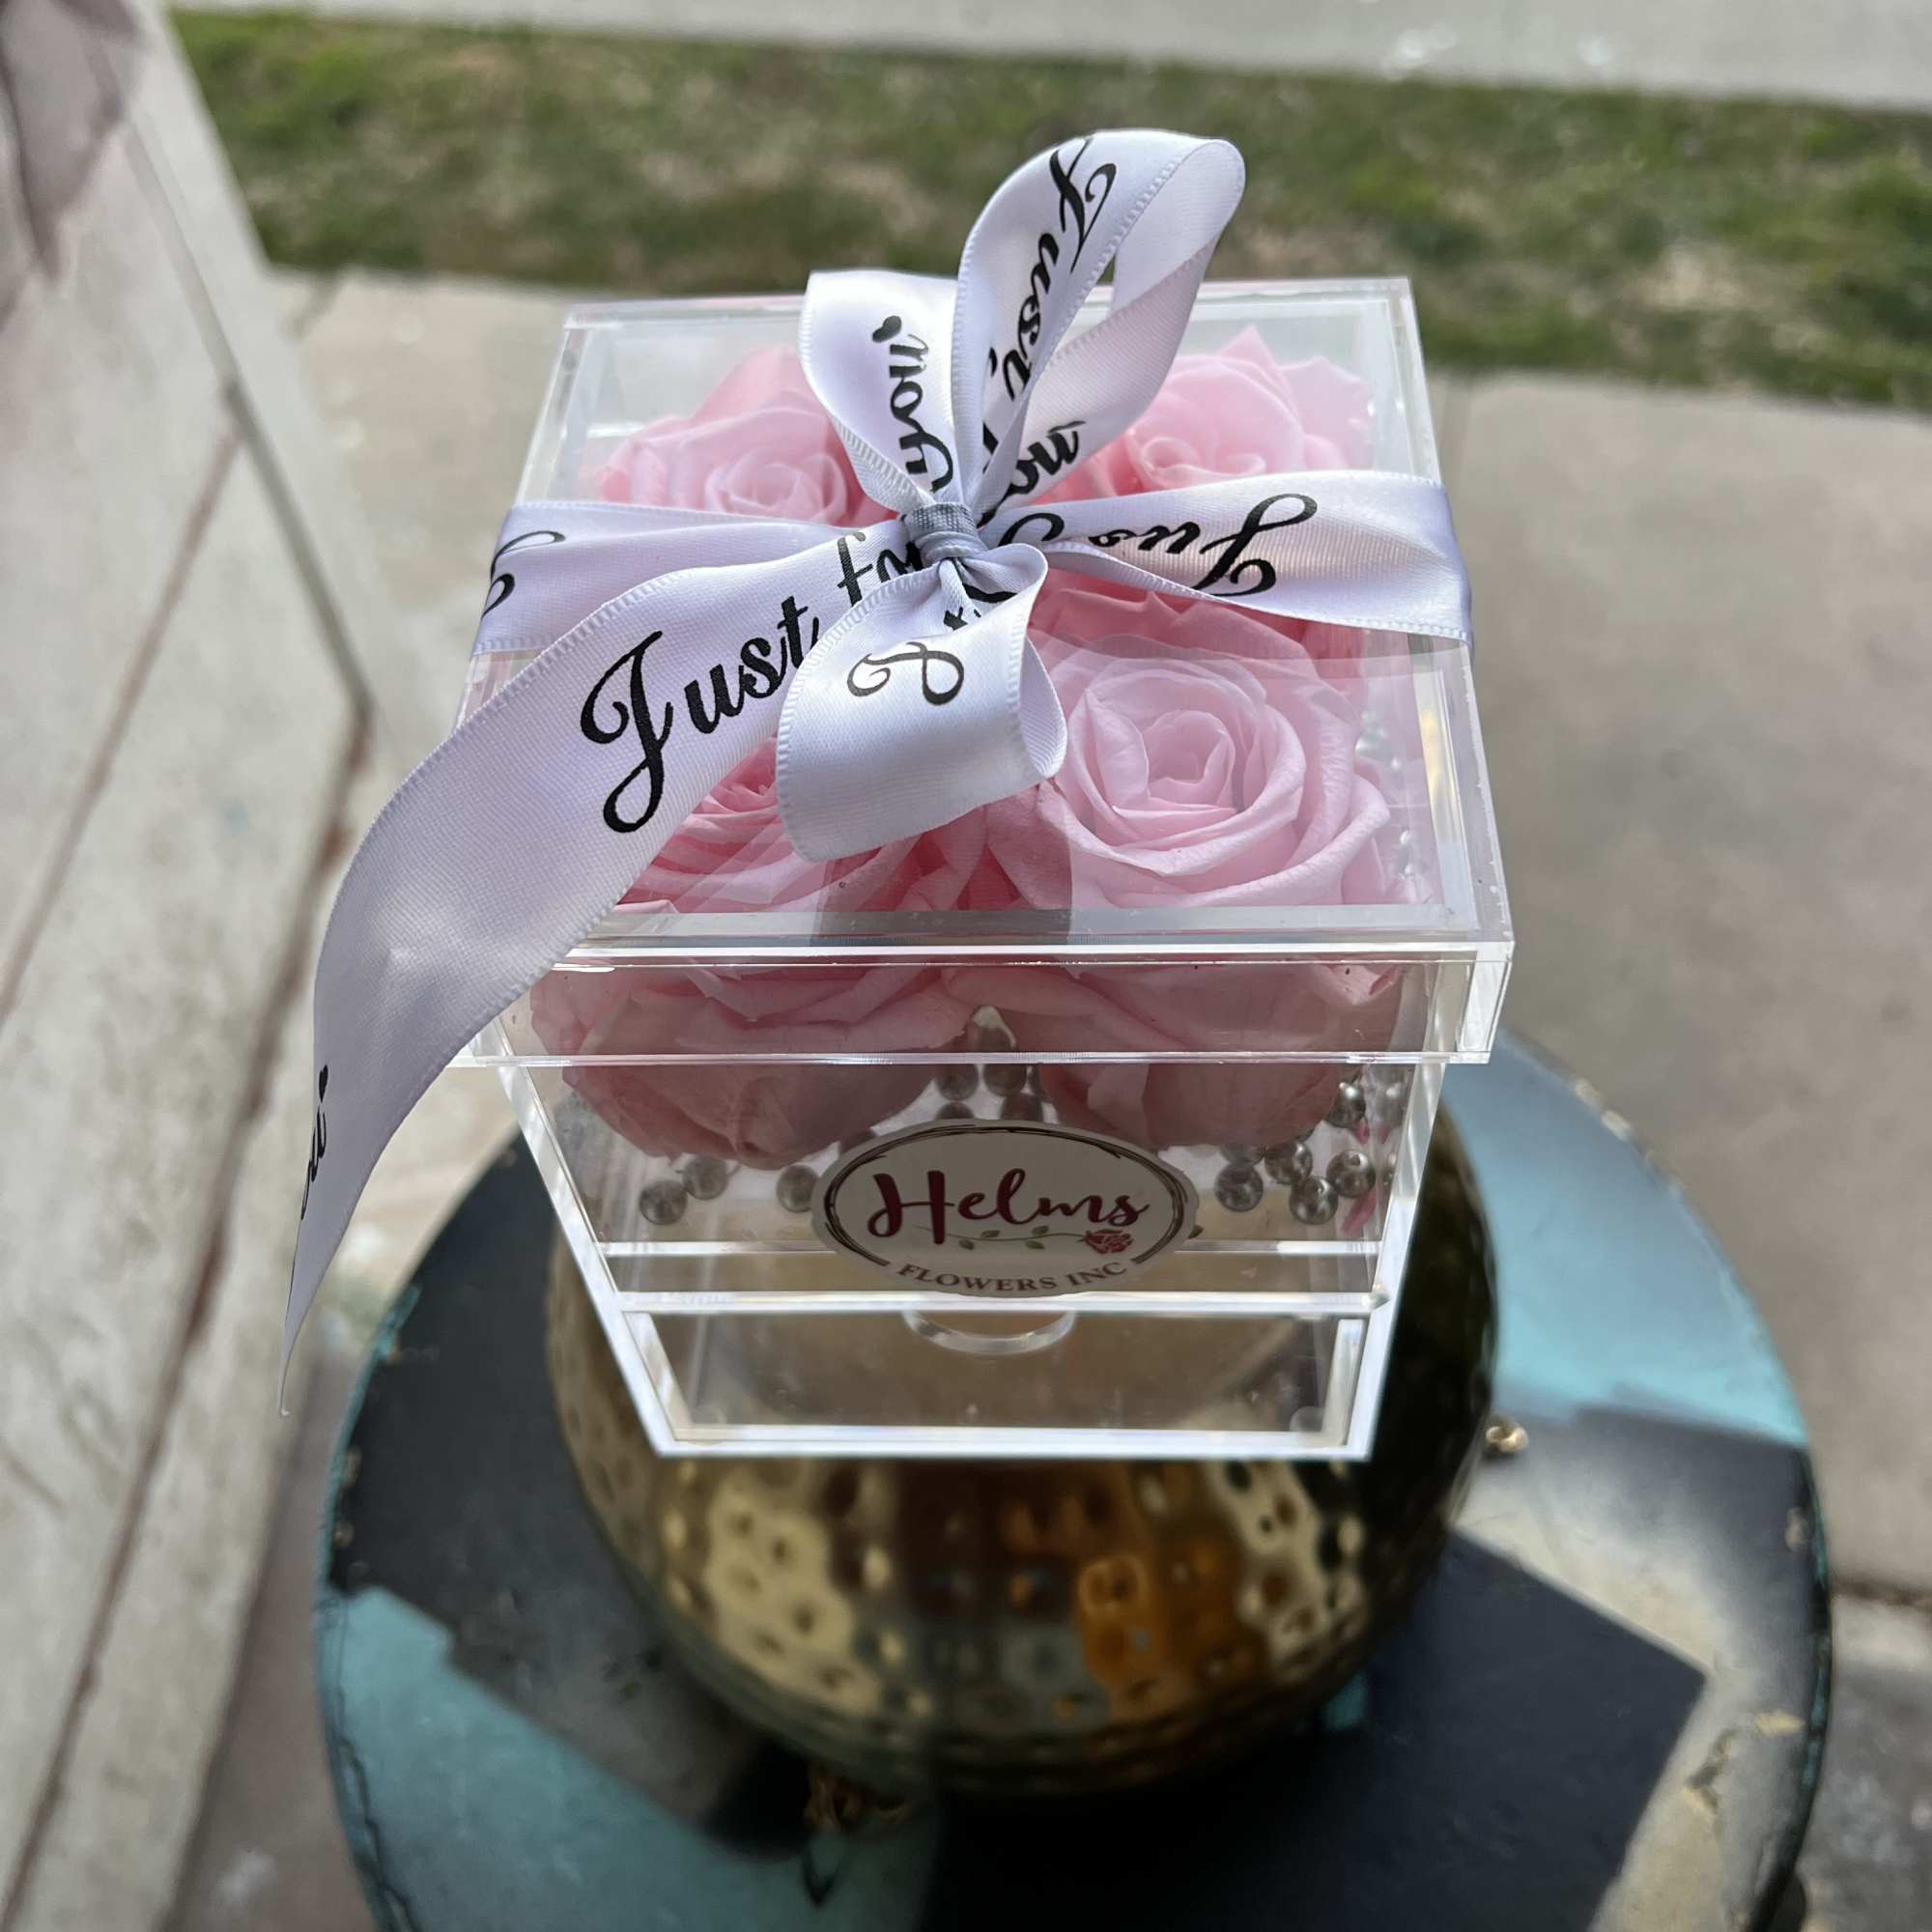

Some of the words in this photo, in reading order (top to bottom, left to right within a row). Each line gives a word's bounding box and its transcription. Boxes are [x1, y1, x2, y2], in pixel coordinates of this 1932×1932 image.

[988, 137, 1117, 401] Just
[888, 332, 955, 494] you
[580, 595, 820, 834] Just
[867, 1168, 1150, 1245] Helms
[897, 1263, 1058, 1293] FLOWERS
[1068, 1262, 1126, 1287] INC
